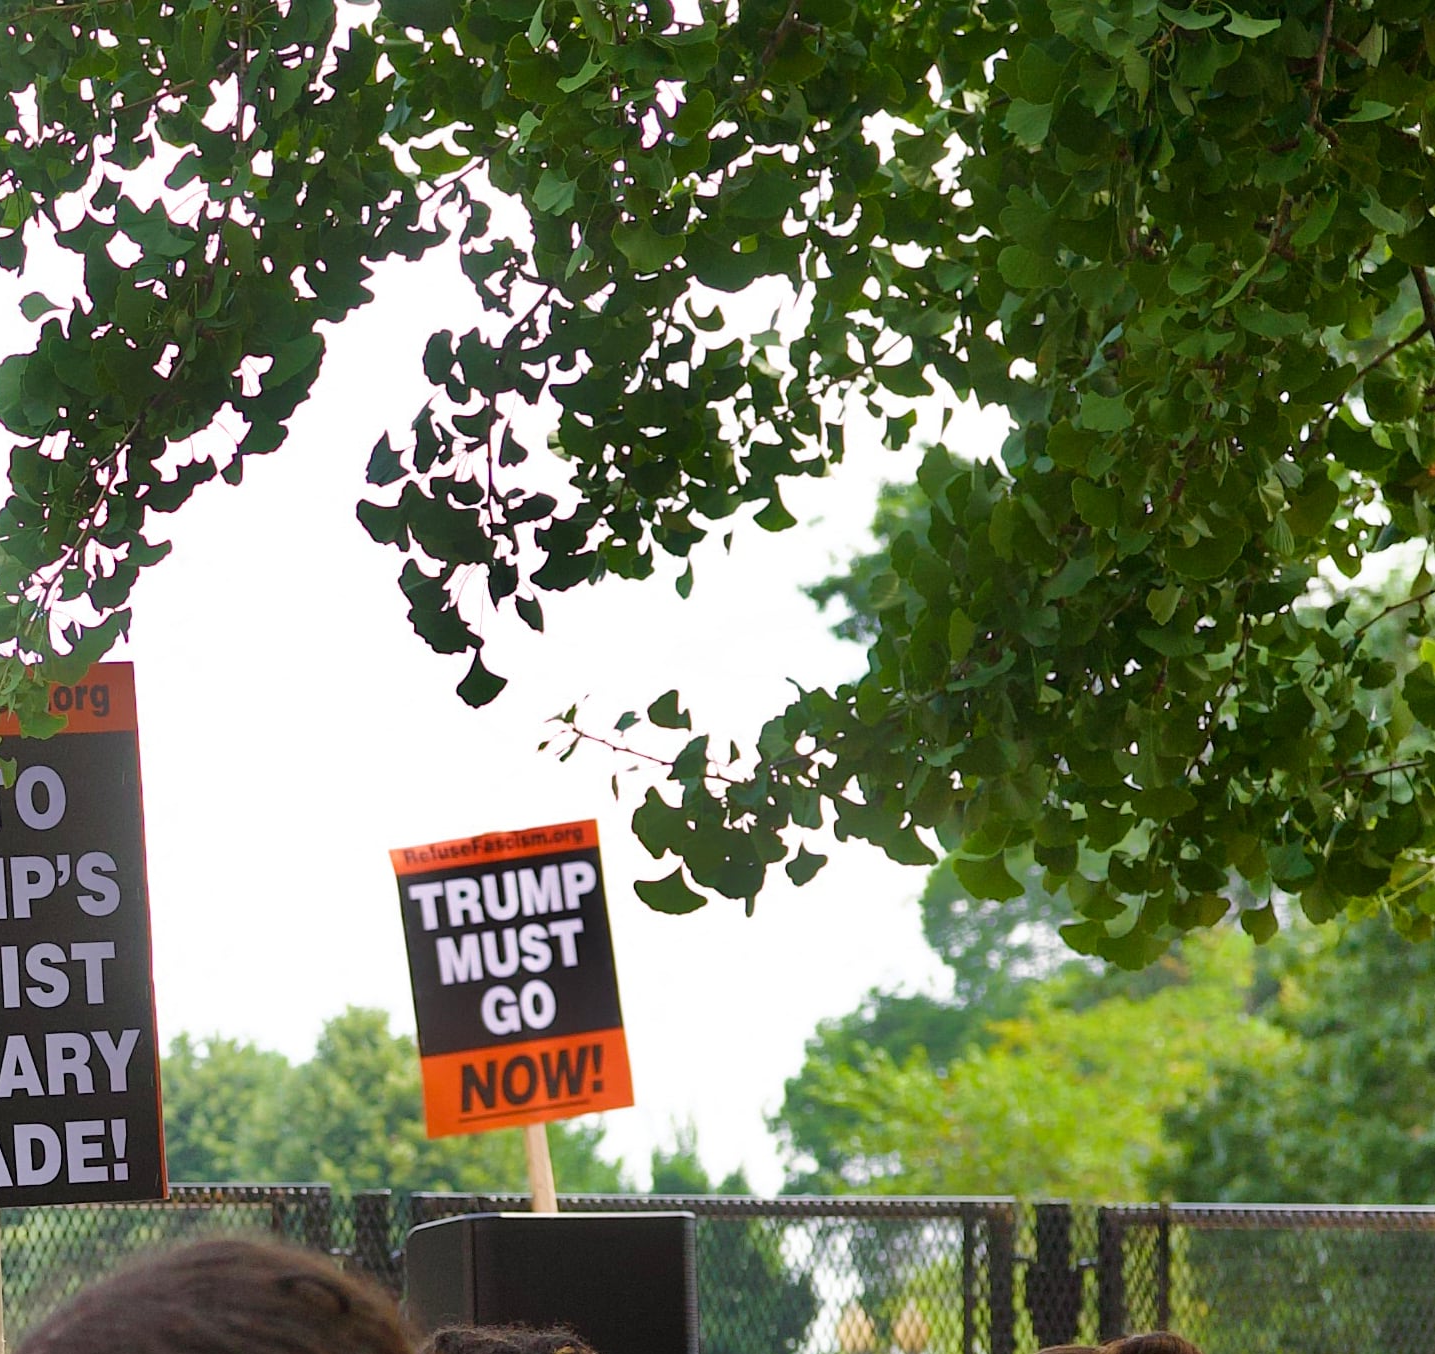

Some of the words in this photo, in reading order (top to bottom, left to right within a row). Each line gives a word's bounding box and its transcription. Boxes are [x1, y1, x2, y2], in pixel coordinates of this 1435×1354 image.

[402, 826, 585, 866] RefuseFascism.org
[407, 860, 598, 932] TRUMP
[435, 917, 585, 986] MUST
[481, 978, 558, 1036] GO
[459, 1043, 605, 1113] NOW!
